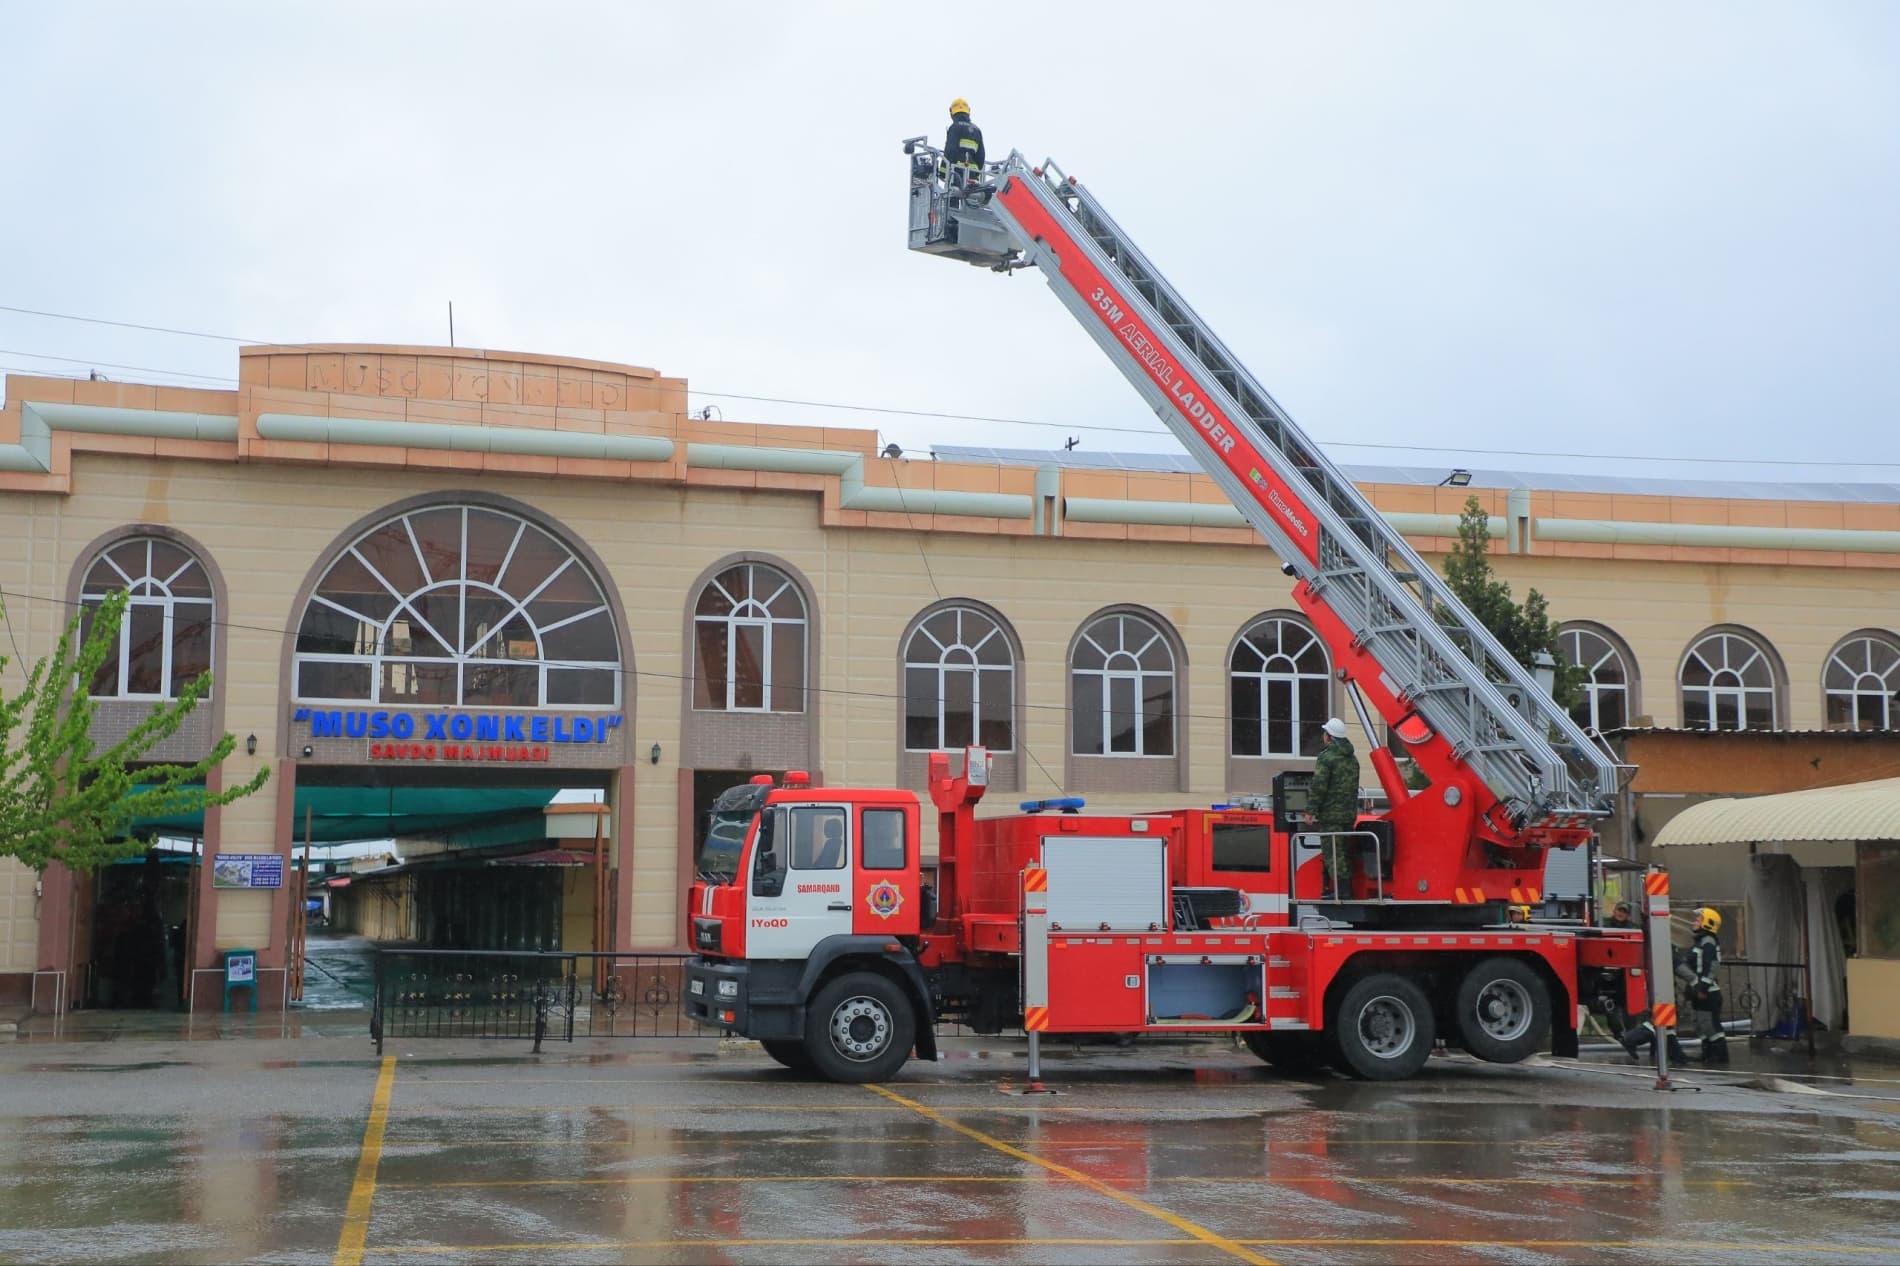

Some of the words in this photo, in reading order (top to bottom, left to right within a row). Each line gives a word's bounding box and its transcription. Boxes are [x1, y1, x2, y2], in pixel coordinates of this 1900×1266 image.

[1091, 287, 1124, 324] 35M
[1119, 323, 1174, 385] AERIAL
[1171, 380, 1237, 454] LADDER
[371, 743, 437, 760] SAVDO
[442, 745, 550, 762] MAJMUASI
